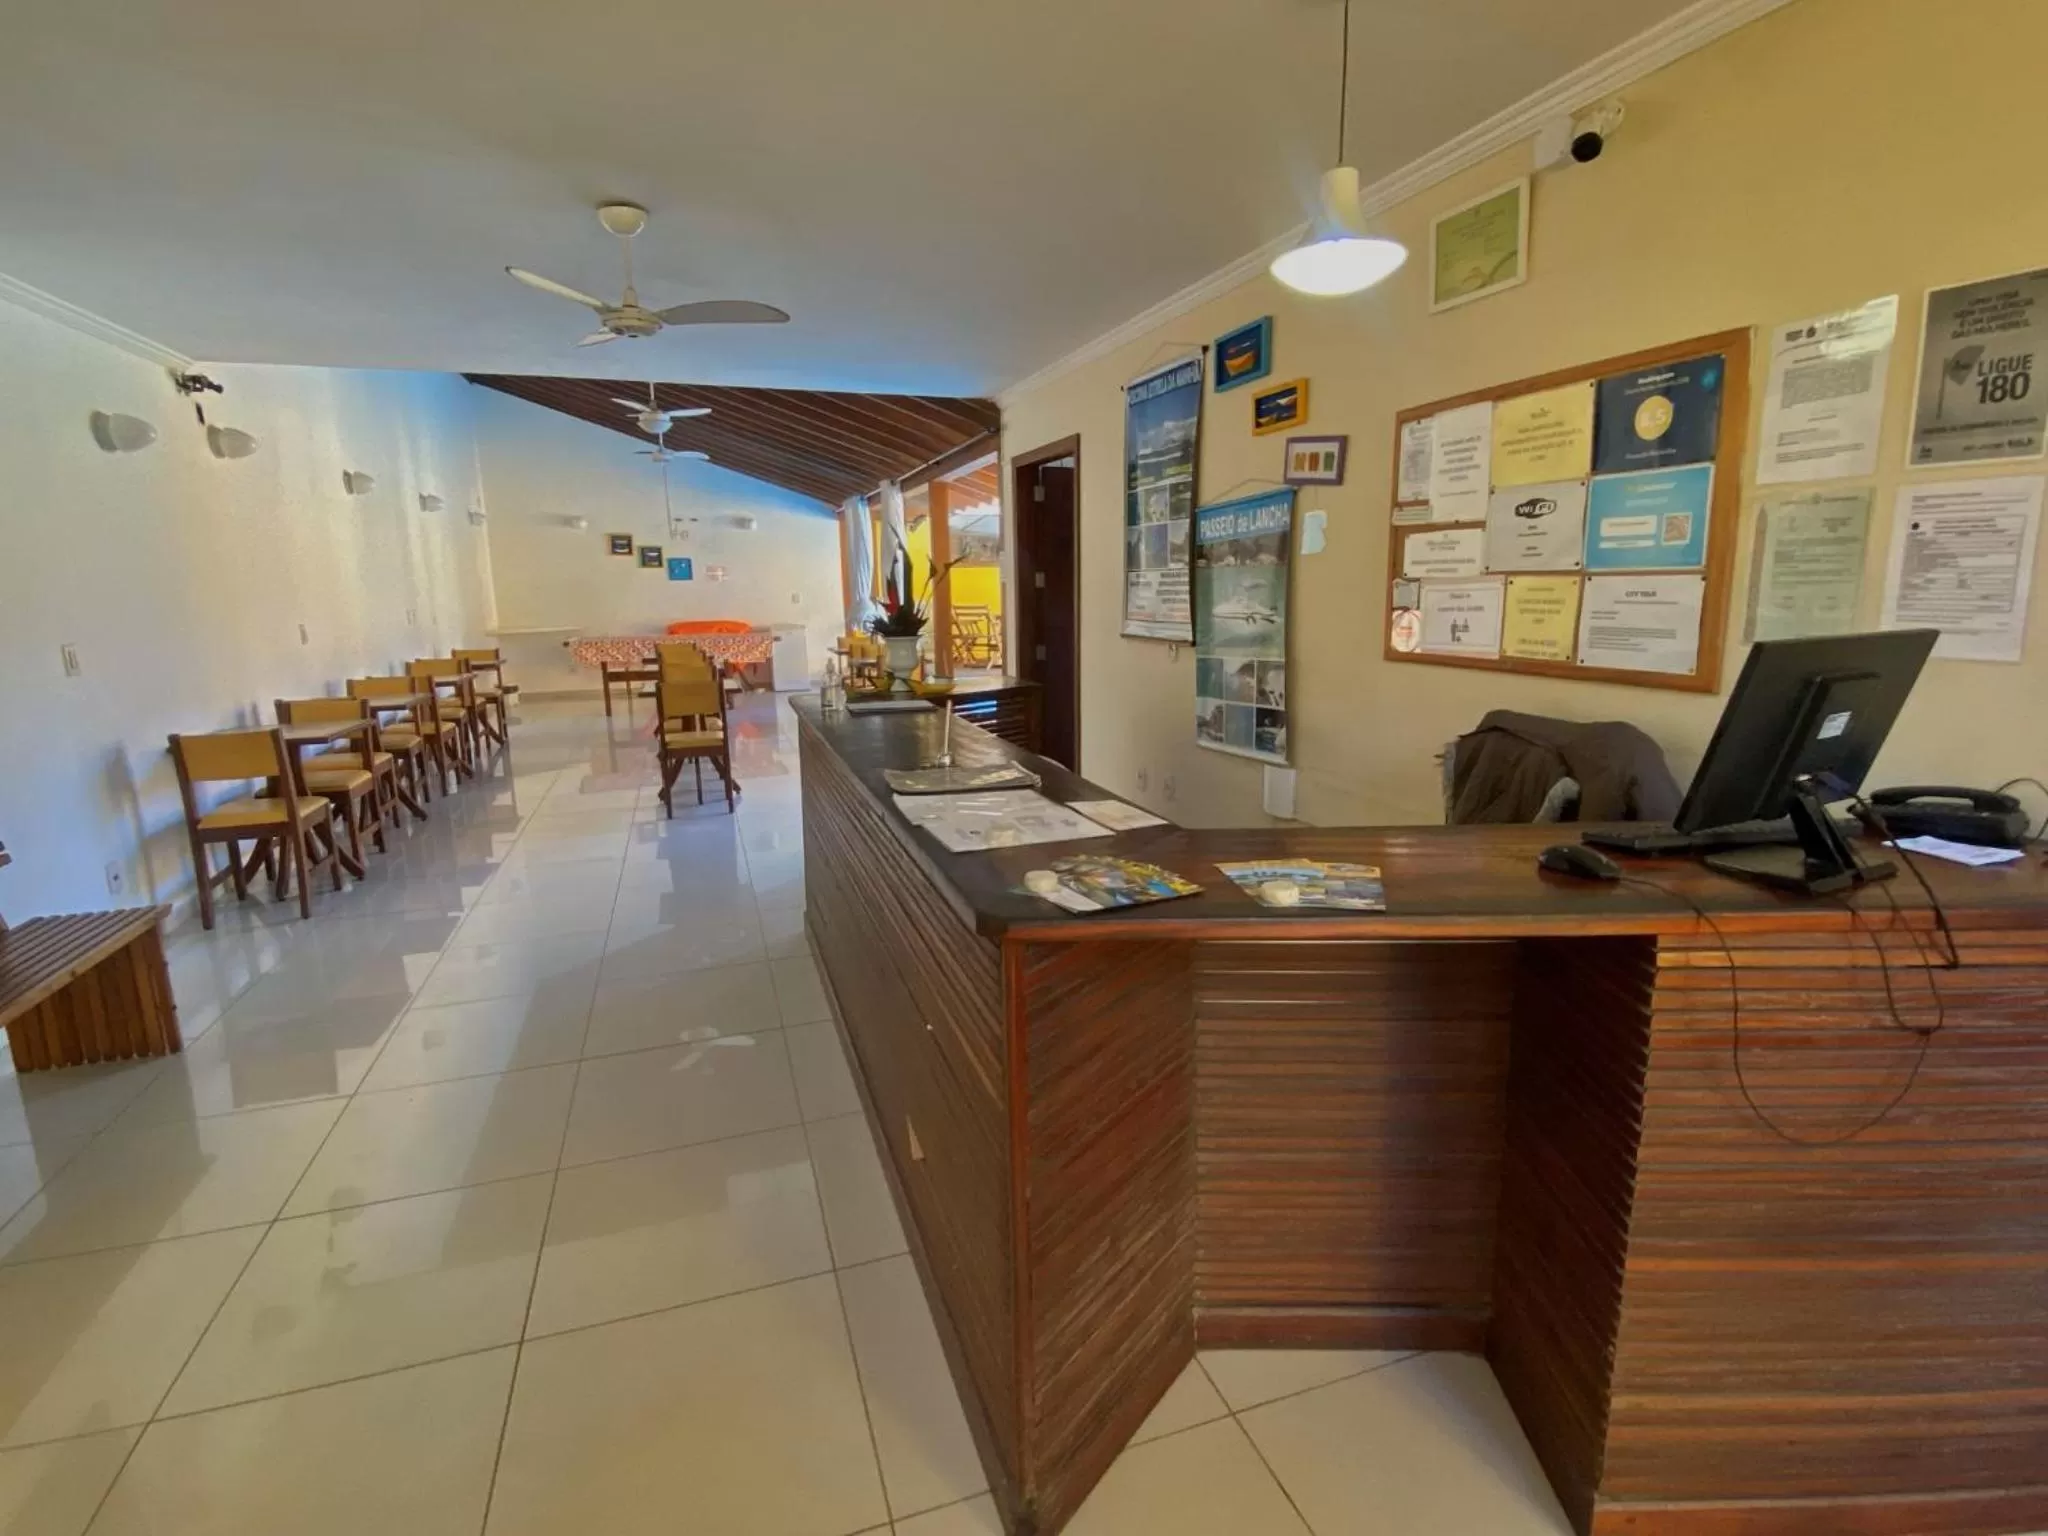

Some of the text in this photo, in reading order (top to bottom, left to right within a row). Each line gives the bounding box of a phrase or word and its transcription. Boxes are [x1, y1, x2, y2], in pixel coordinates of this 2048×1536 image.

[1977, 354, 2033, 376] LIGUE
[1976, 371, 2030, 404] 180
[1200, 502, 1290, 539] PASSEIO de LANCHA
